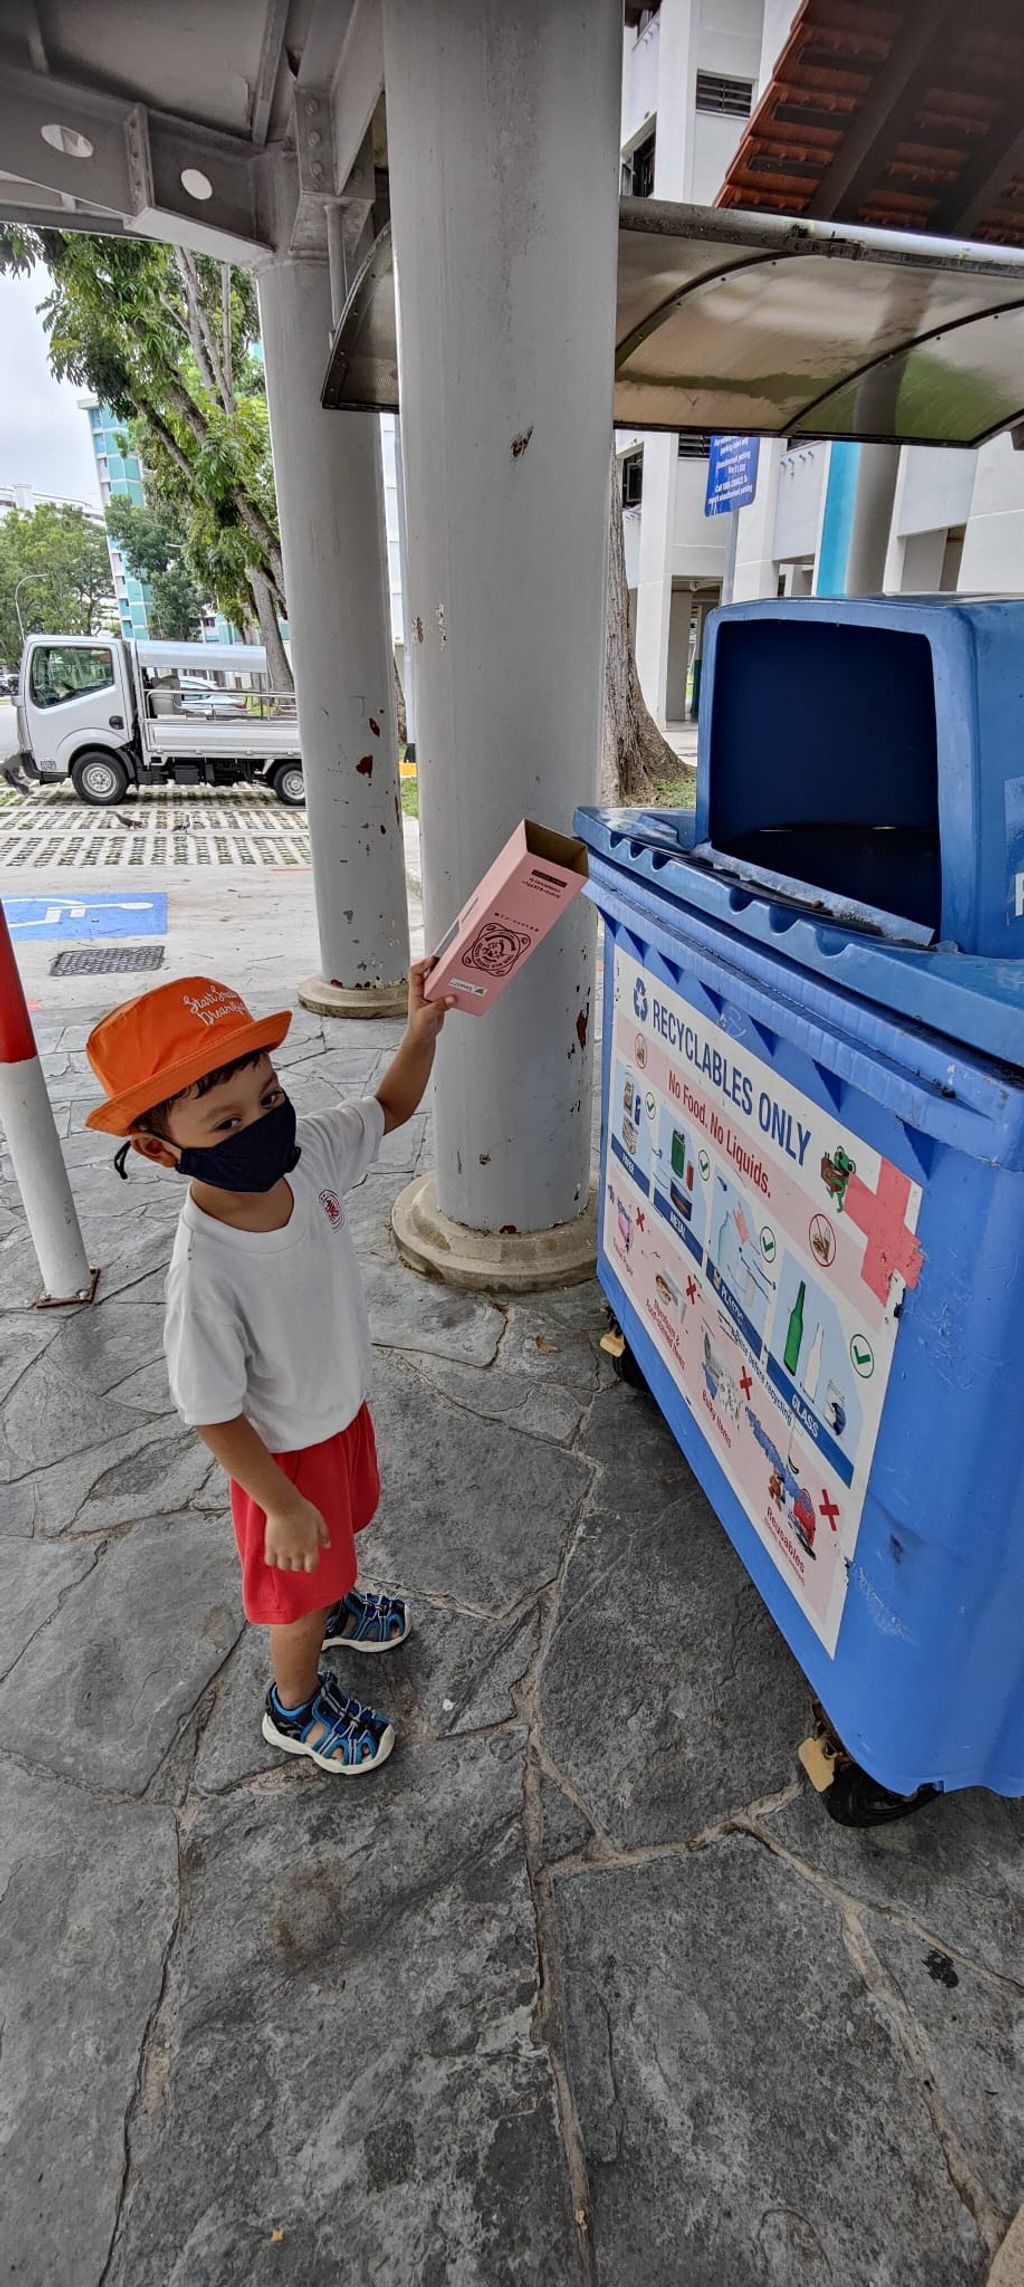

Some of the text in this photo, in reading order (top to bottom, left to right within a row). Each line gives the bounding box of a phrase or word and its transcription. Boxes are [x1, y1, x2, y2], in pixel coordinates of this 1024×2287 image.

[652, 998, 813, 1167] RECYCLABLES ONLY
[668, 1070, 772, 1198] No Food. No Liquids.
[670, 1210, 686, 1240] METAL
[748, 1353, 765, 1385] before
[765, 1381, 792, 1427] recycling
[791, 1394, 820, 1438] GLASS
[766, 1505, 806, 1574] Reusables
